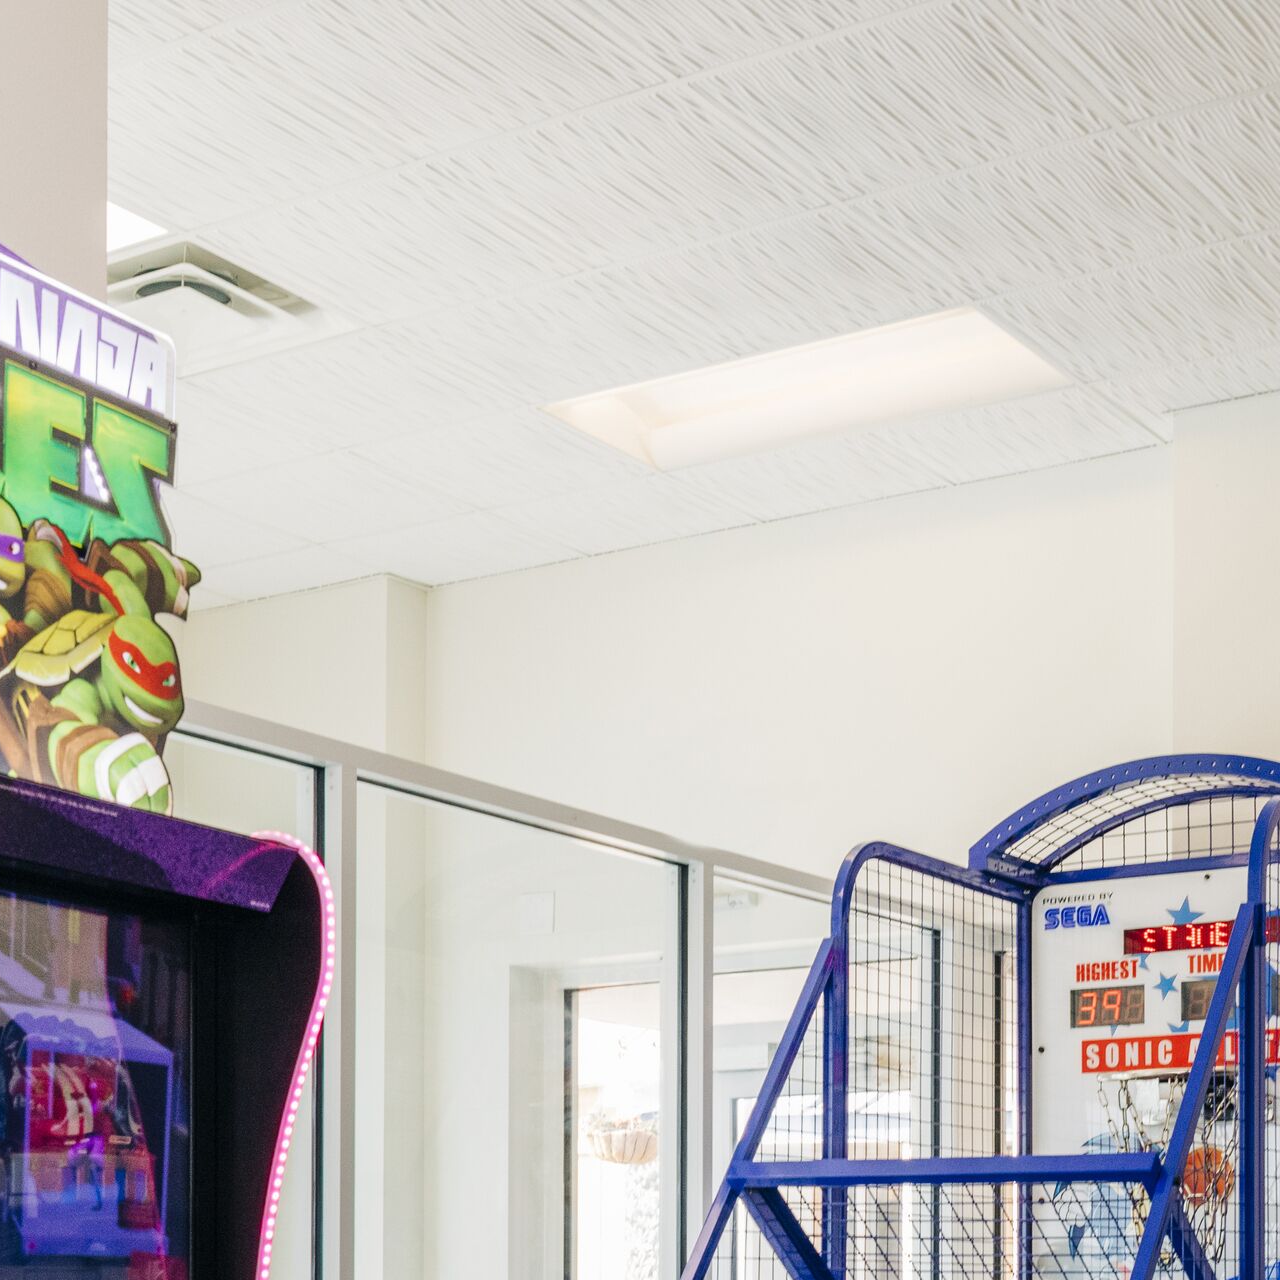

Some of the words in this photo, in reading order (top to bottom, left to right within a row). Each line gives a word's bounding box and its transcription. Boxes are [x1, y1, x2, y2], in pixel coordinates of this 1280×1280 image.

[1042, 893, 1096, 905] POWERED
[1099, 891, 1114, 901] BY
[1044, 904, 1110, 930] SEGA
[1075, 959, 1138, 983] HIGHEST
[1086, 1039, 1173, 1069] SONIC
